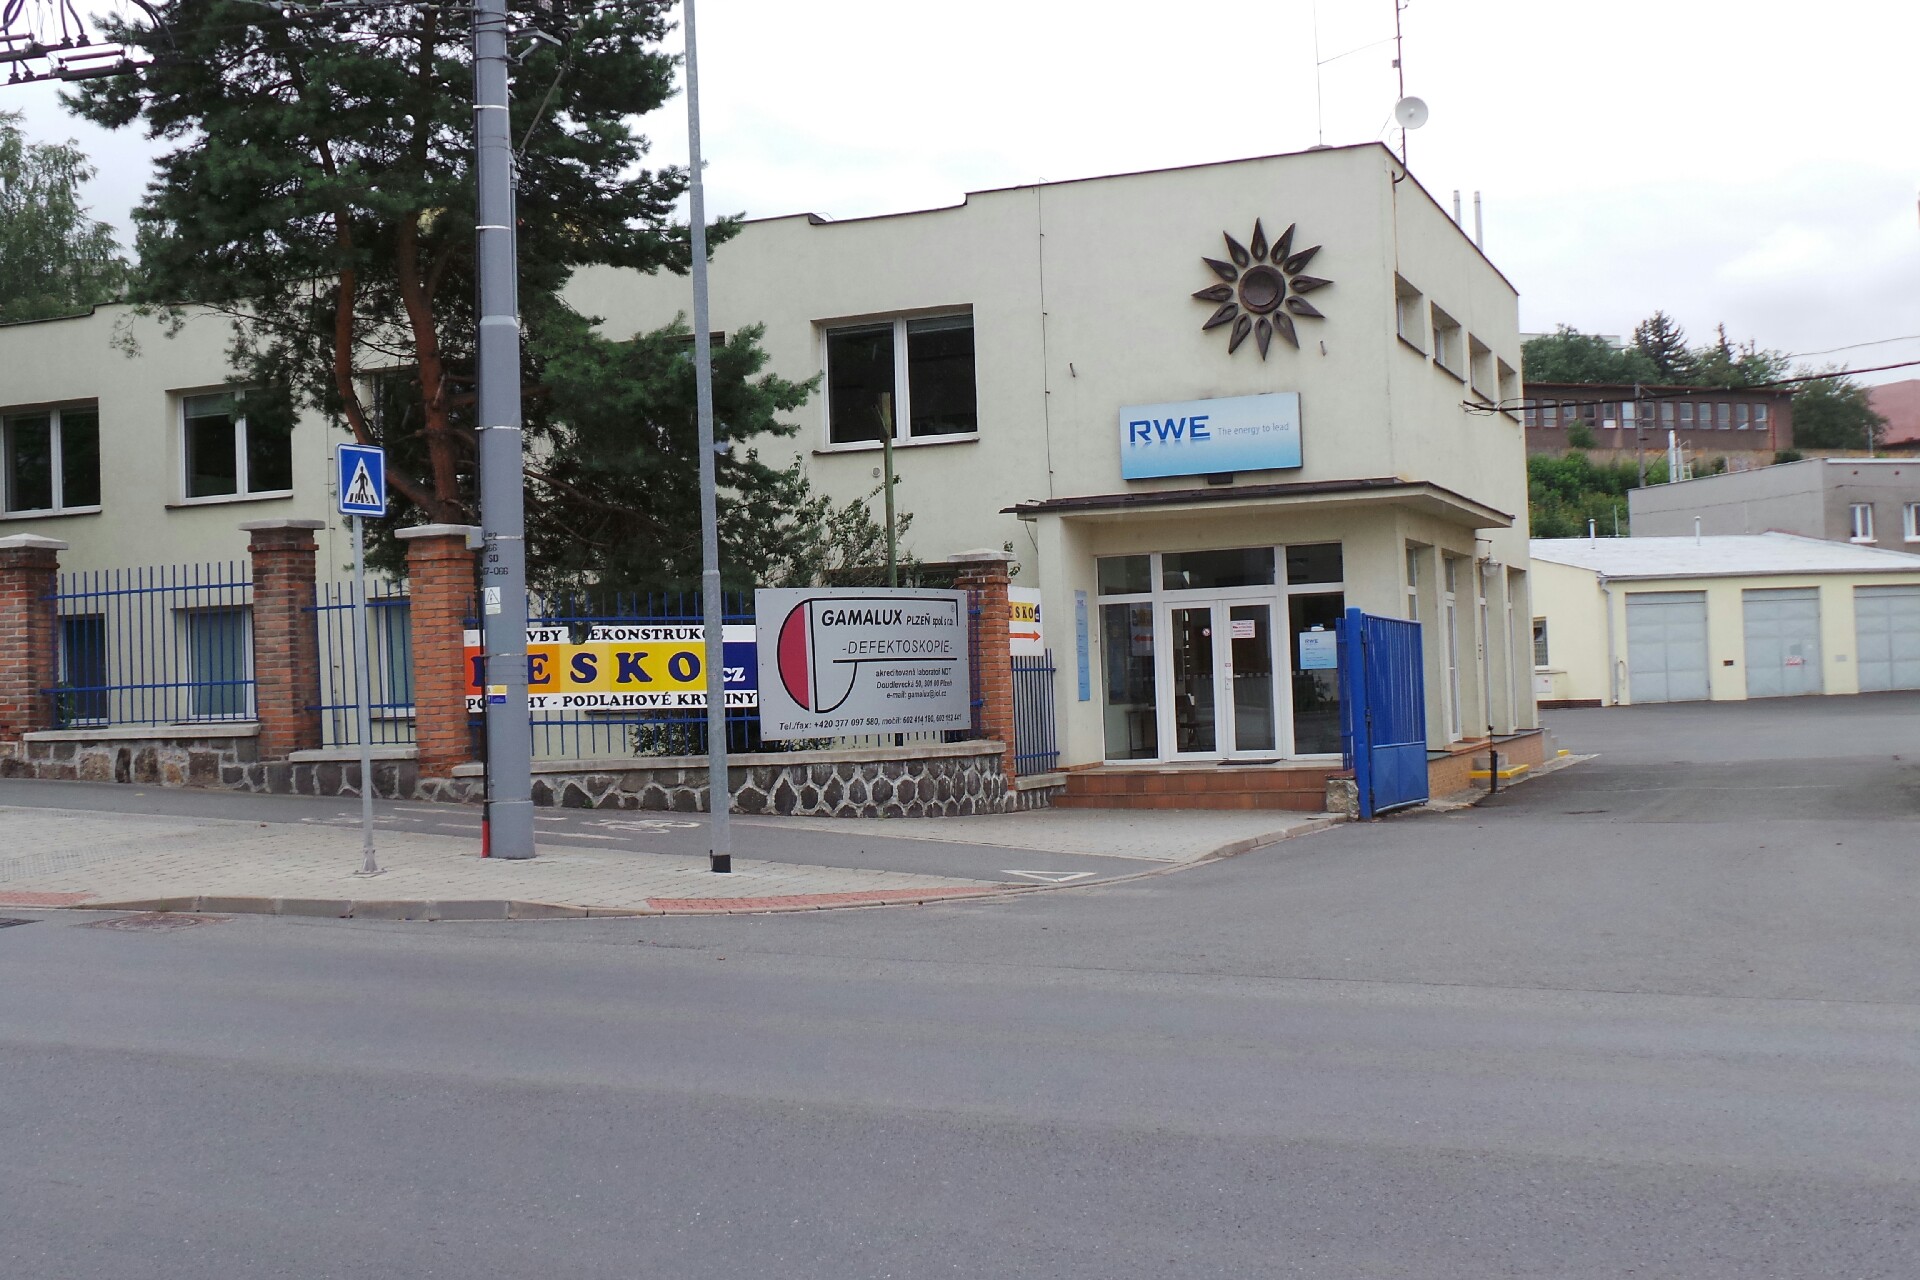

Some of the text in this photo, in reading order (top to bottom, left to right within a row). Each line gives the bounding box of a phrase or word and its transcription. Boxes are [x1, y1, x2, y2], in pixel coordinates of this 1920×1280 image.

[1129, 415, 1211, 443] RWE
[1217, 422, 1289, 436] The energy to lead
[821, 609, 903, 627] GAMALUX
[906, 612, 931, 626] PLZEŇ
[562, 691, 672, 708] PODLAHOVÉ
[814, 719, 834, 729] +420
[834, 719, 849, 728] 377
[850, 718, 864, 727] 097
